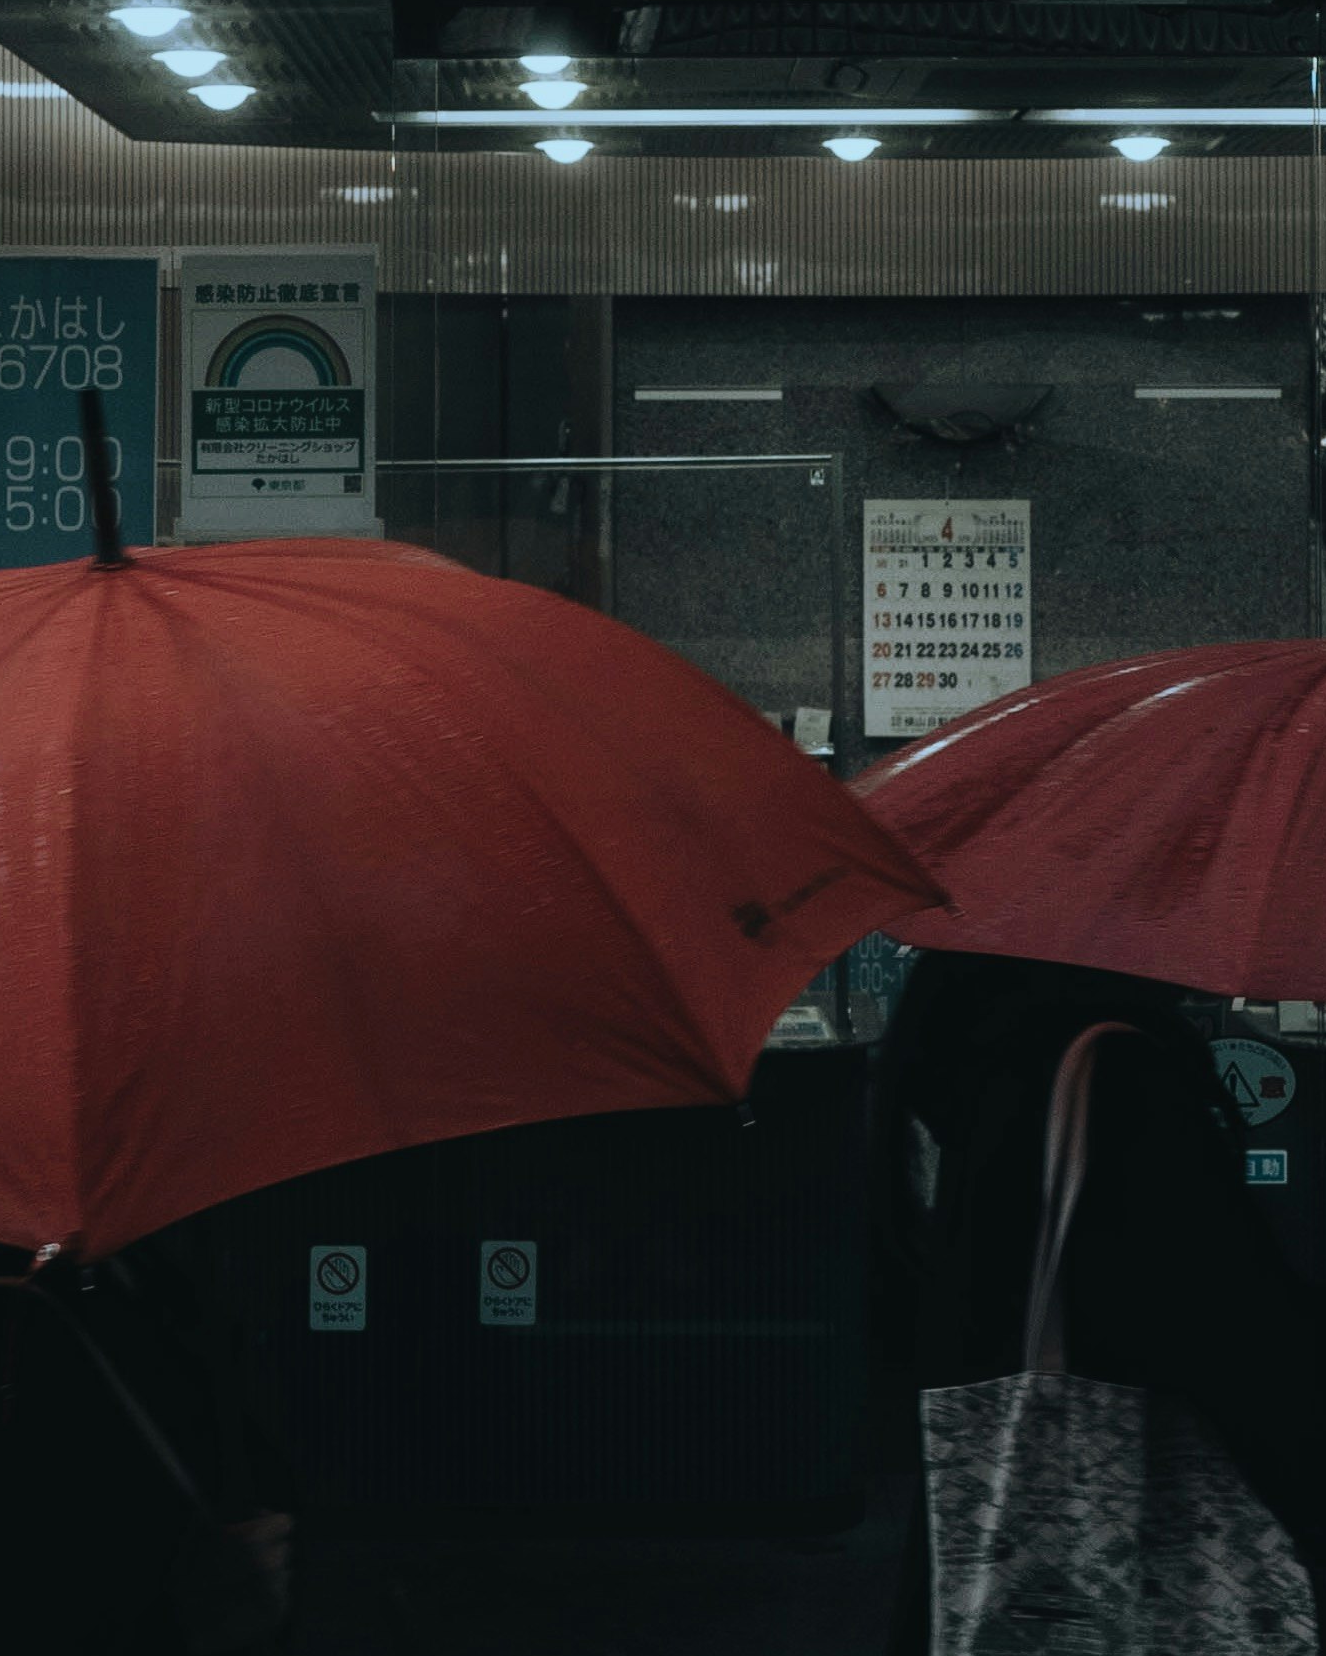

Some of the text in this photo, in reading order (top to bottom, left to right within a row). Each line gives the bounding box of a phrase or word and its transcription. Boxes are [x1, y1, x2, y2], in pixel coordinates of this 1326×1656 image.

[195, 283, 361, 304] 感染防止徹底宣言
[204, 397, 351, 414] 新型コロナウイルス
[215, 416, 342, 433] 感染拡大防止中
[941, 516, 953, 542] 4
[922, 554, 928, 568] 1
[943, 554, 953, 568] 2
[965, 553, 974, 568] 3
[987, 553, 996, 568] 4
[1009, 553, 1018, 568] 5
[877, 583, 1023, 597] 6 7 8 9 10 11 12
[874, 613, 1023, 628] 13 14 15 16 17 18 19
[873, 643, 1023, 658] 20 21 22 23 24 25 26
[873, 673, 957, 688] 27 28 29 30
